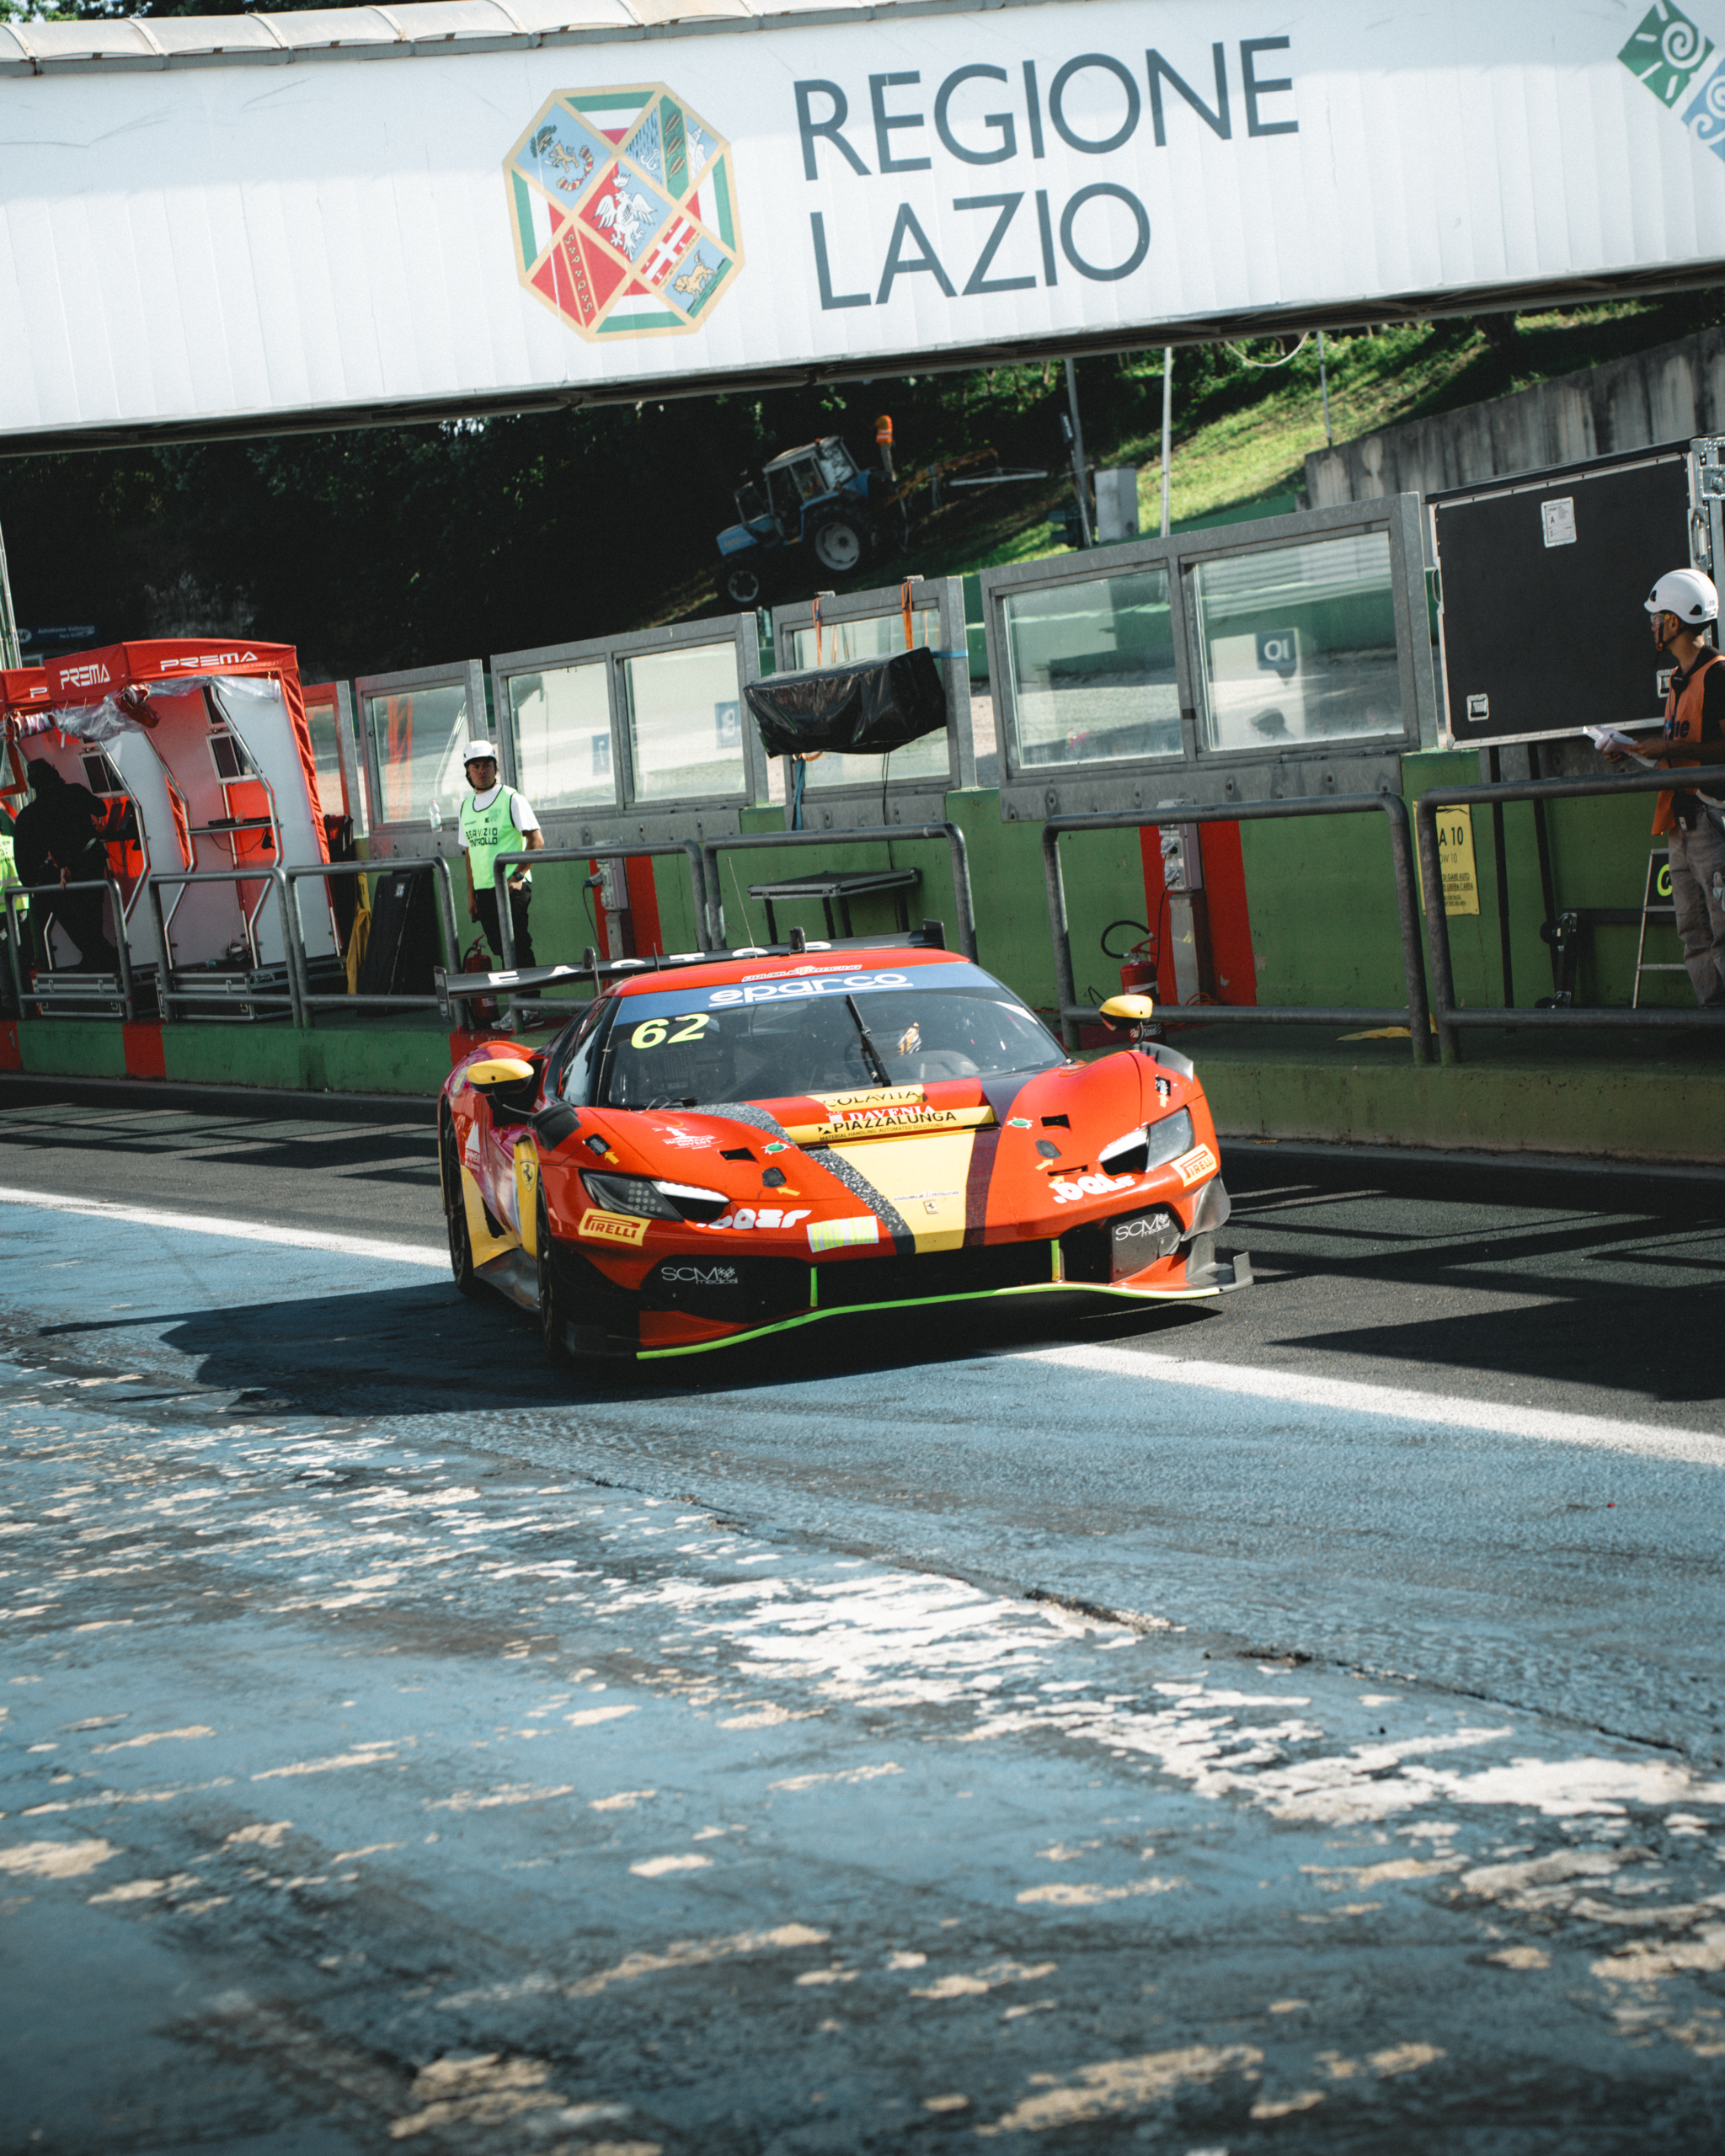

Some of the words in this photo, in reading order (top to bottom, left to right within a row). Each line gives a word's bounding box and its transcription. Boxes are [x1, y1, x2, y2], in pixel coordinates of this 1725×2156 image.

[793, 35, 1299, 181] REGIONE
[809, 182, 1151, 311] LAZIO
[160, 651, 259, 672] PREMA
[60, 664, 111, 691] PREMA
[466, 827, 498, 840] SERVIZIO
[1451, 826, 1464, 846] 10
[709, 973, 907, 1004] sparco
[631, 1013, 709, 1049] 62
[823, 1091, 921, 1107] COLAVITA
[833, 1111, 958, 1133] PIAZZALUNGA
[847, 1104, 936, 1121] DAVENIA
[820, 1133, 847, 1141] MATERIAL
[879, 1125, 912, 1134] AUTOMATED
[1179, 1150, 1214, 1179] PIRELLI
[583, 1214, 641, 1239] PIRELLI
[811, 1220, 845, 1252] PRO
[848, 1217, 875, 1246] AM
[1114, 1215, 1160, 1241] SCM
[1140, 1219, 1171, 1238] medical
[660, 1266, 718, 1282] SCM
[696, 1276, 739, 1285] medical
